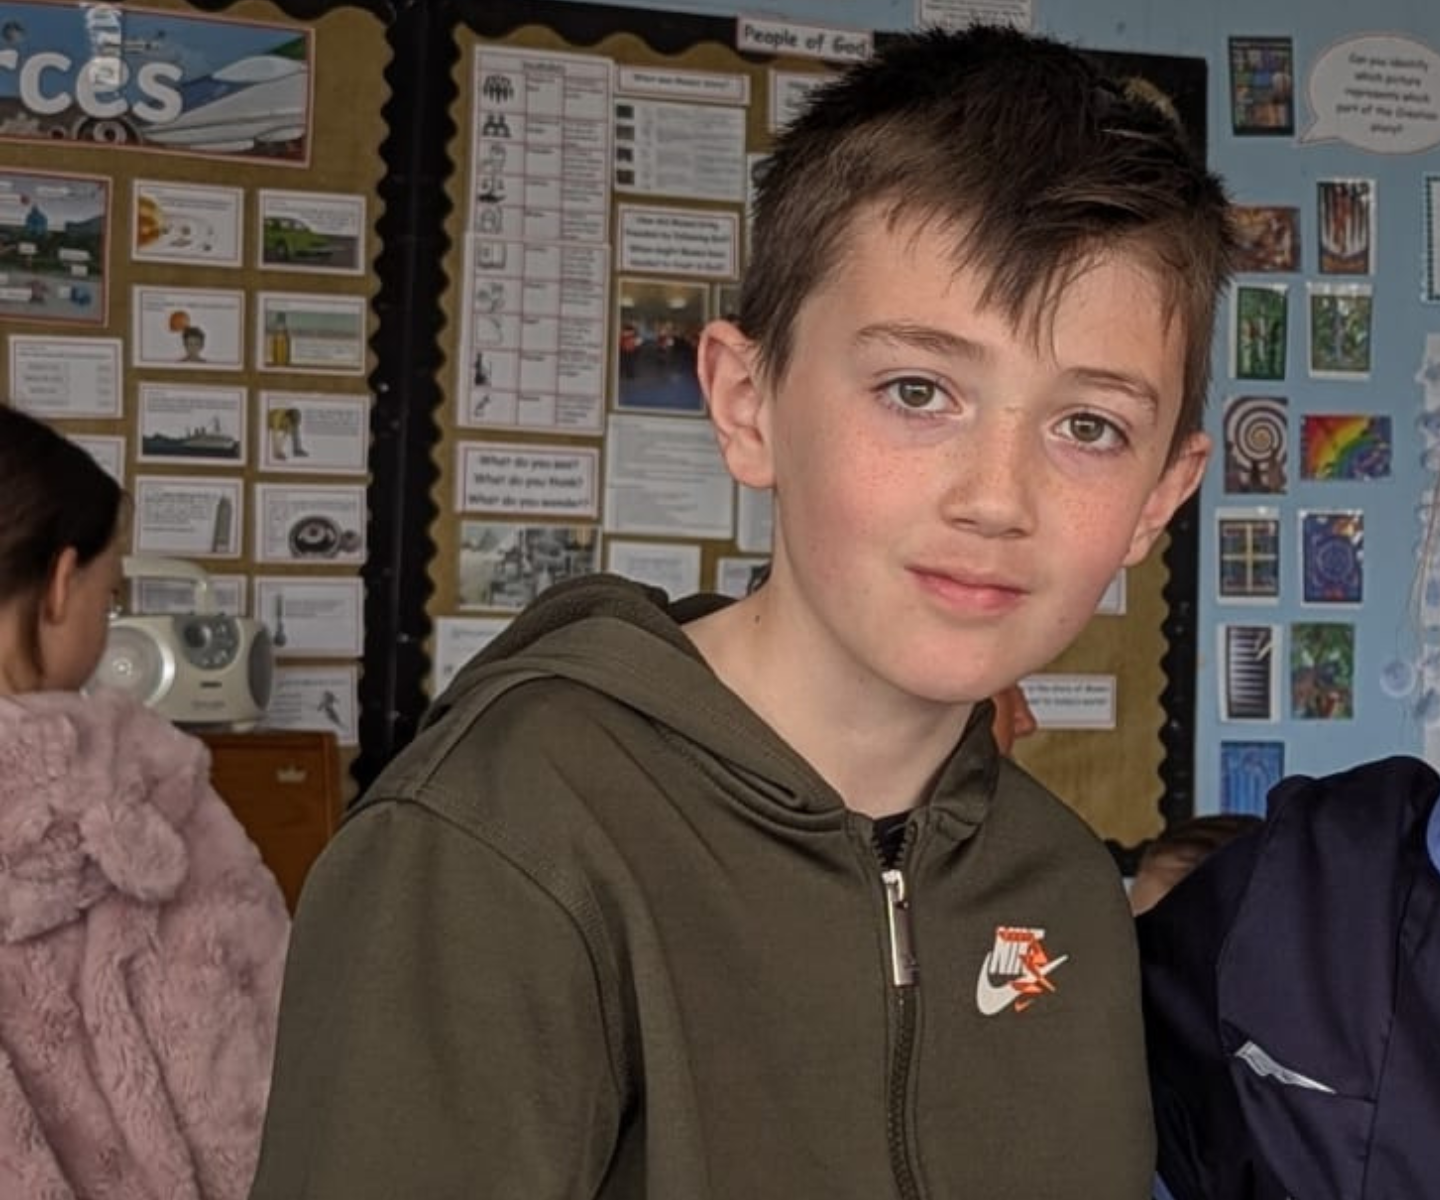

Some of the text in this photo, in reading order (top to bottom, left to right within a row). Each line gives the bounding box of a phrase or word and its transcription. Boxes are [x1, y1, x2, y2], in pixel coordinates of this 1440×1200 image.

[745, 24, 866, 58] People of God
[1348, 51, 1428, 73] Can you identify
[1354, 72, 1422, 89] which picture
[1344, 87, 1430, 104] represents which
[1336, 103, 1438, 120] part of the Creation
[1370, 123, 1403, 137] story?
[481, 456, 510, 468] What
[515, 456, 528, 469] do
[531, 460, 551, 473] you
[474, 473, 583, 490] What do you think?
[469, 493, 500, 506] What
[503, 494, 516, 506] do
[520, 497, 540, 511] you
